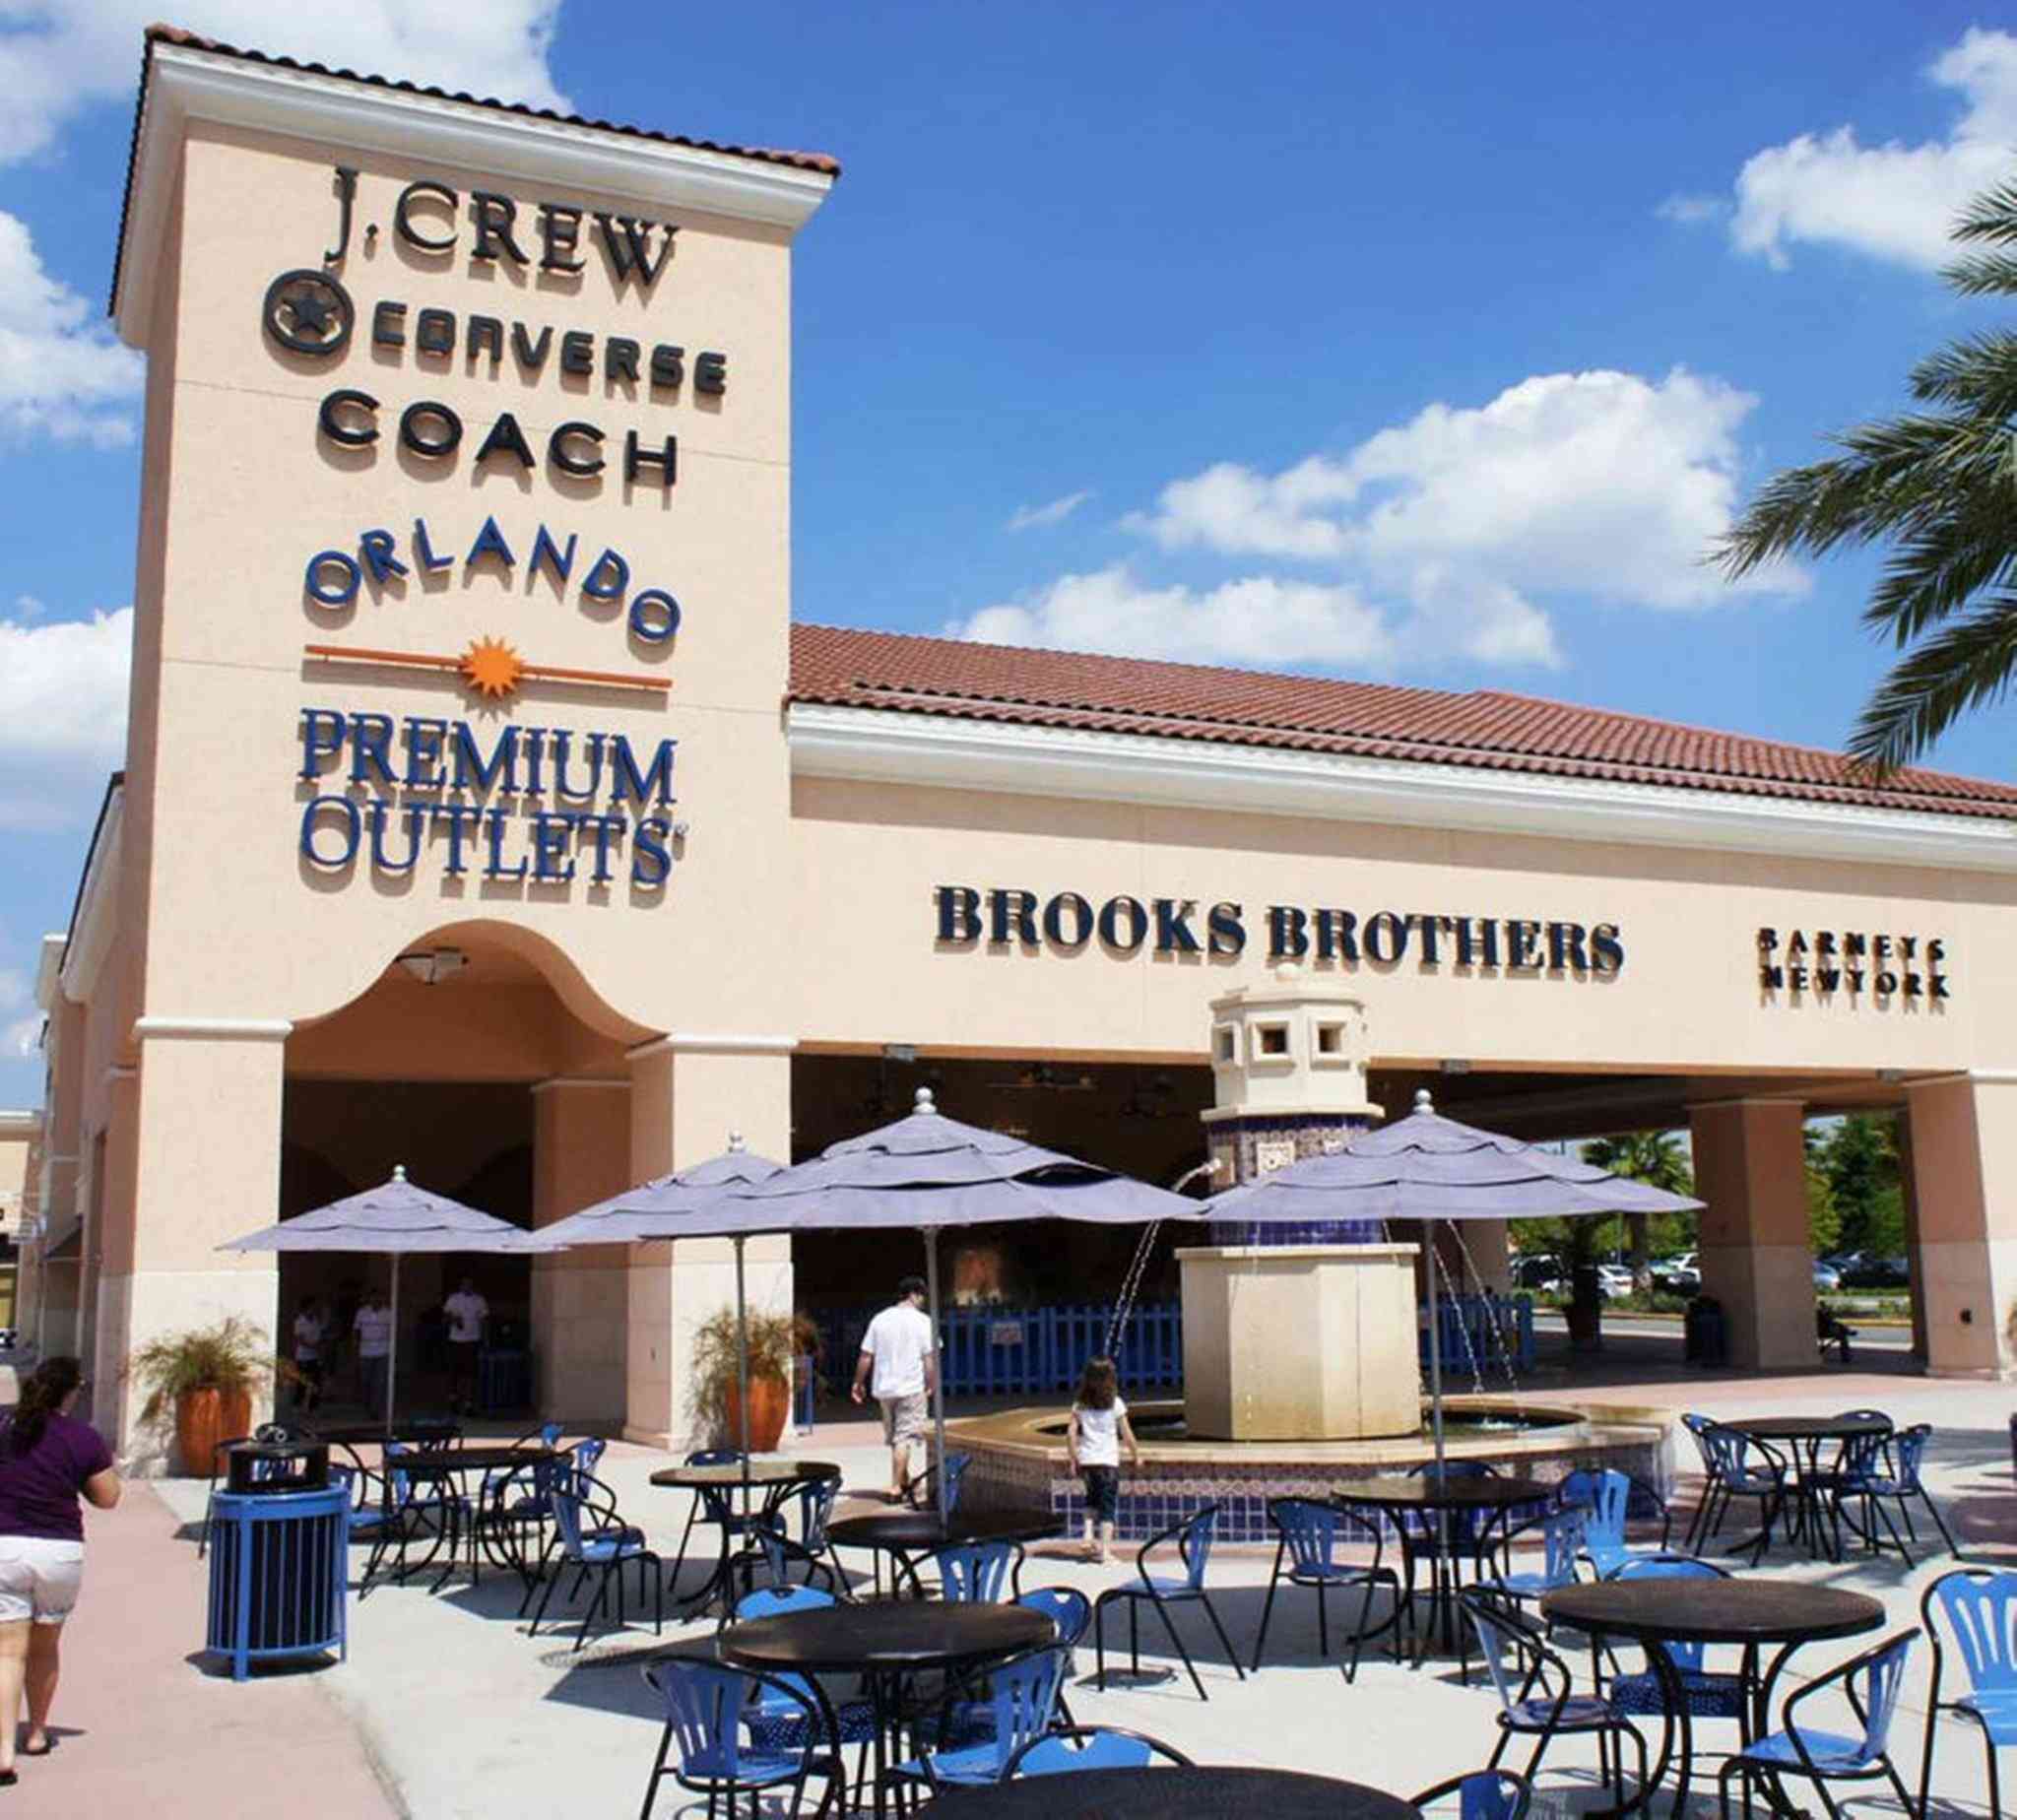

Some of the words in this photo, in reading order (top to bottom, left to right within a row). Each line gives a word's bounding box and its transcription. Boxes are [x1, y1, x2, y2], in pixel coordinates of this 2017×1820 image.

[372, 299, 728, 396] CONVERSE
[319, 388, 678, 488] COACH
[304, 514, 682, 640] ORLANDO
[297, 707, 679, 806] PREMIUM
[935, 884, 1247, 955] BROOKS
[1267, 904, 1626, 972] BROTHERS
[1758, 927, 1945, 960] BARNEYS
